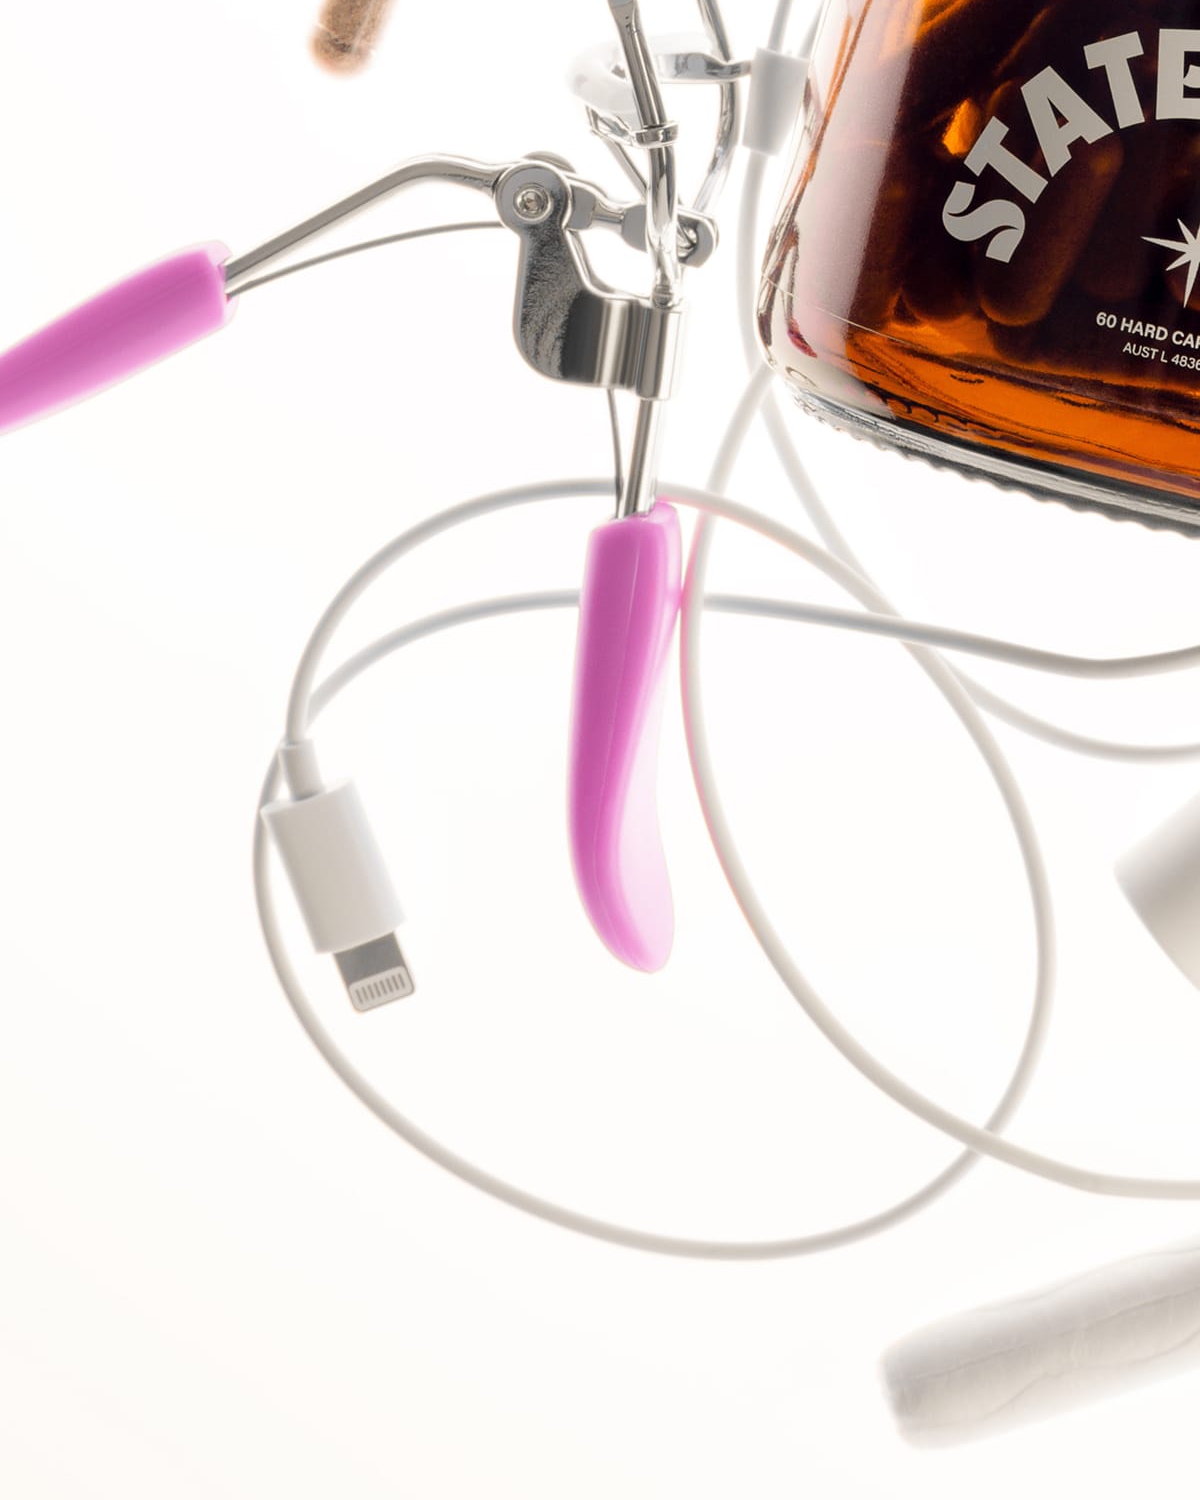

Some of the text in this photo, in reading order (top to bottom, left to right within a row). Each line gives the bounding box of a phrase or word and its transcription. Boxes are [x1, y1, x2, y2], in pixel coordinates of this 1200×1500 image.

[1096, 311, 1117, 329] 60
[1120, 317, 1169, 341] HARD
[1122, 342, 1159, 360] AUST
[1160, 350, 1169, 364] L
